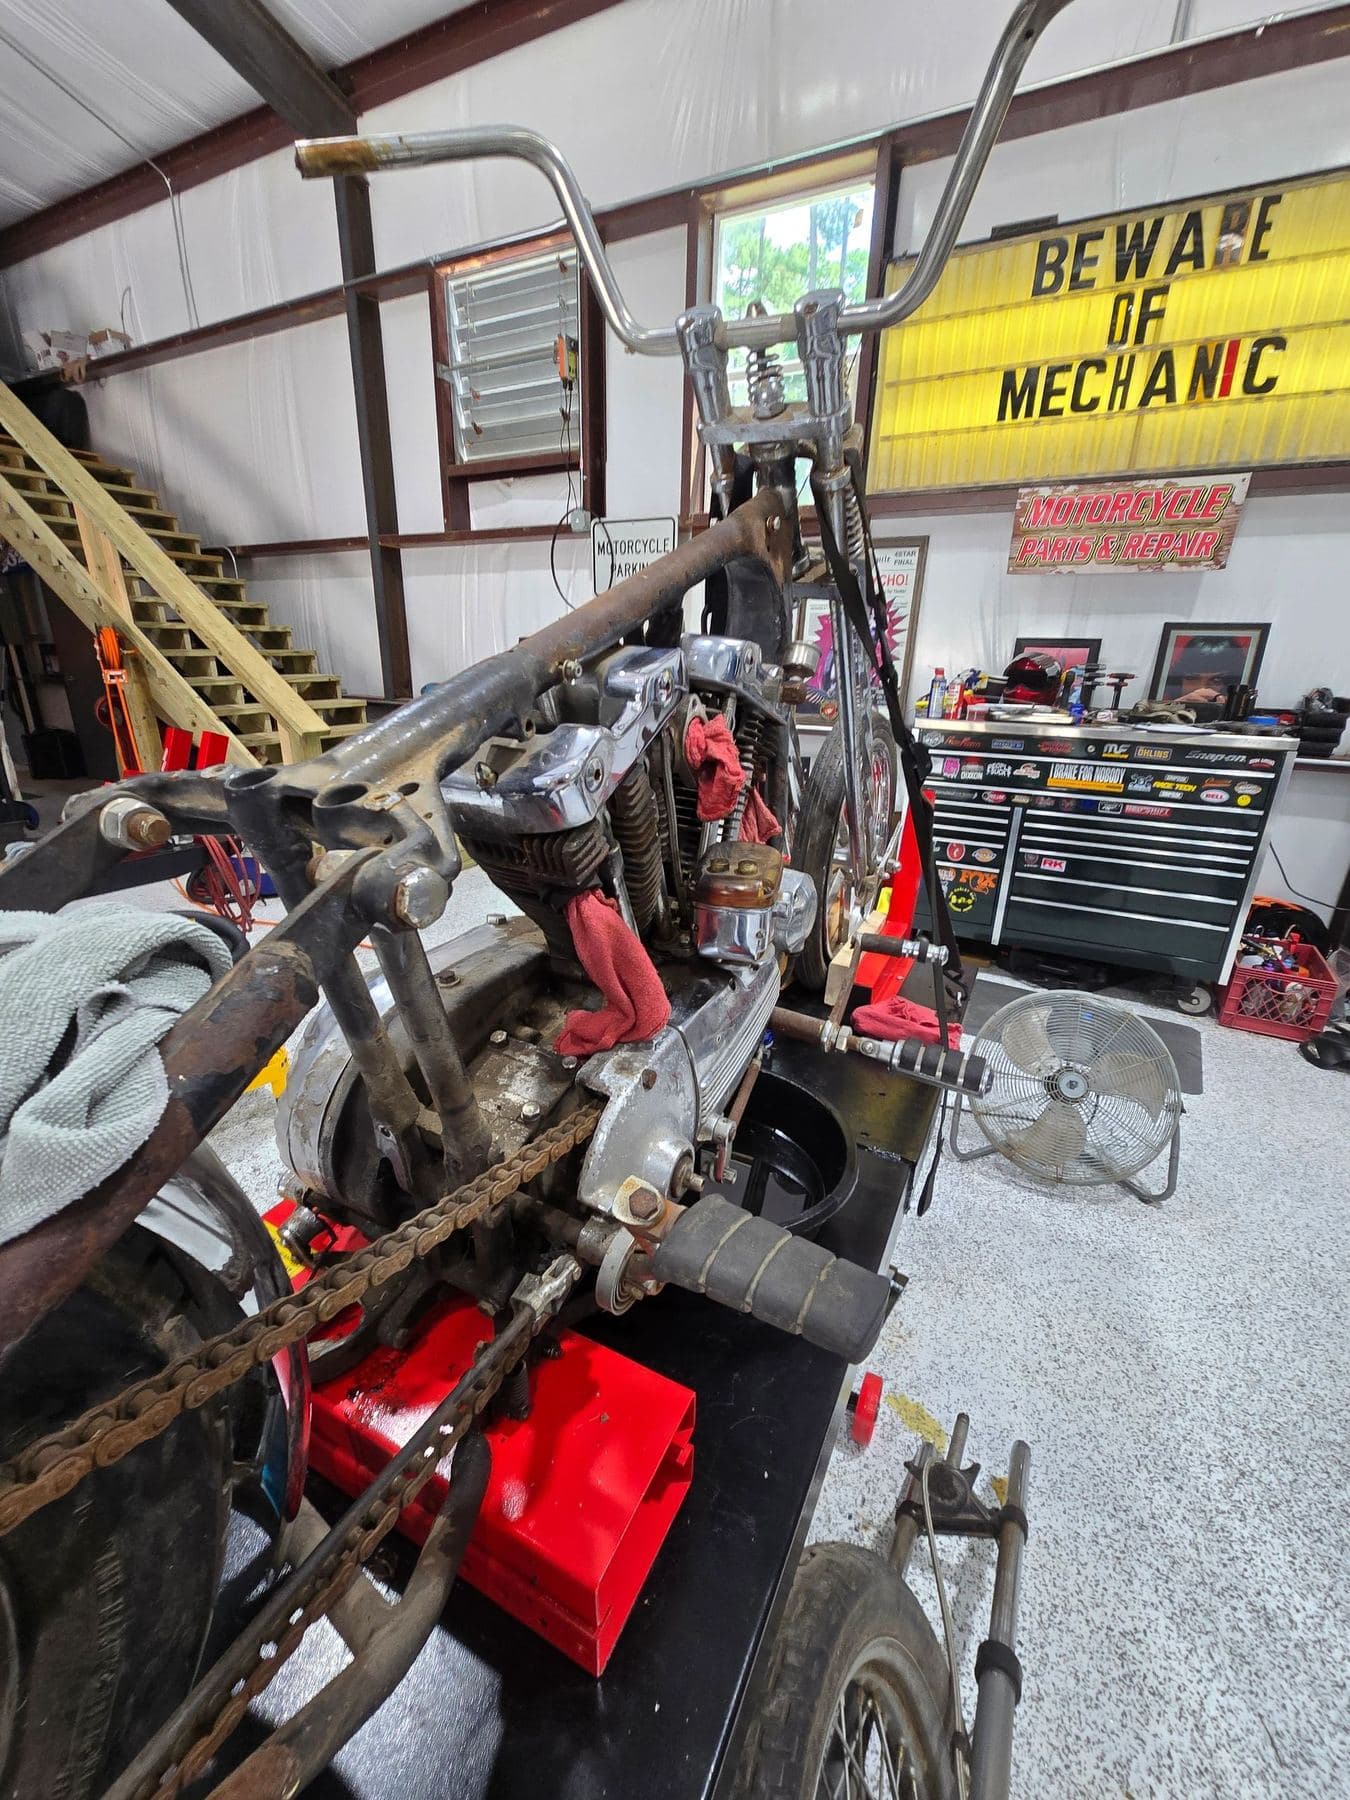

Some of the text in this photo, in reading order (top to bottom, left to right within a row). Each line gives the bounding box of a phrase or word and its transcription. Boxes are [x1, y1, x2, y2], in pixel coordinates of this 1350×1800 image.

[1031, 195, 1282, 296] BEWARE
[1107, 285, 1171, 348] OF
[997, 336, 1286, 422] MECHANIC
[1022, 485, 1232, 529] MOTORCYCLE
[597, 538, 670, 556] MOTORCYCLE
[1016, 530, 1220, 565] PARTS & REPAIR
[1050, 763, 1055, 778] I
[1054, 764, 1079, 781] BRAKE
[1078, 765, 1094, 782] FOR
[1093, 766, 1126, 784] NOBODY
[959, 870, 998, 889] FOX
[1042, 859, 1063, 869] RK
